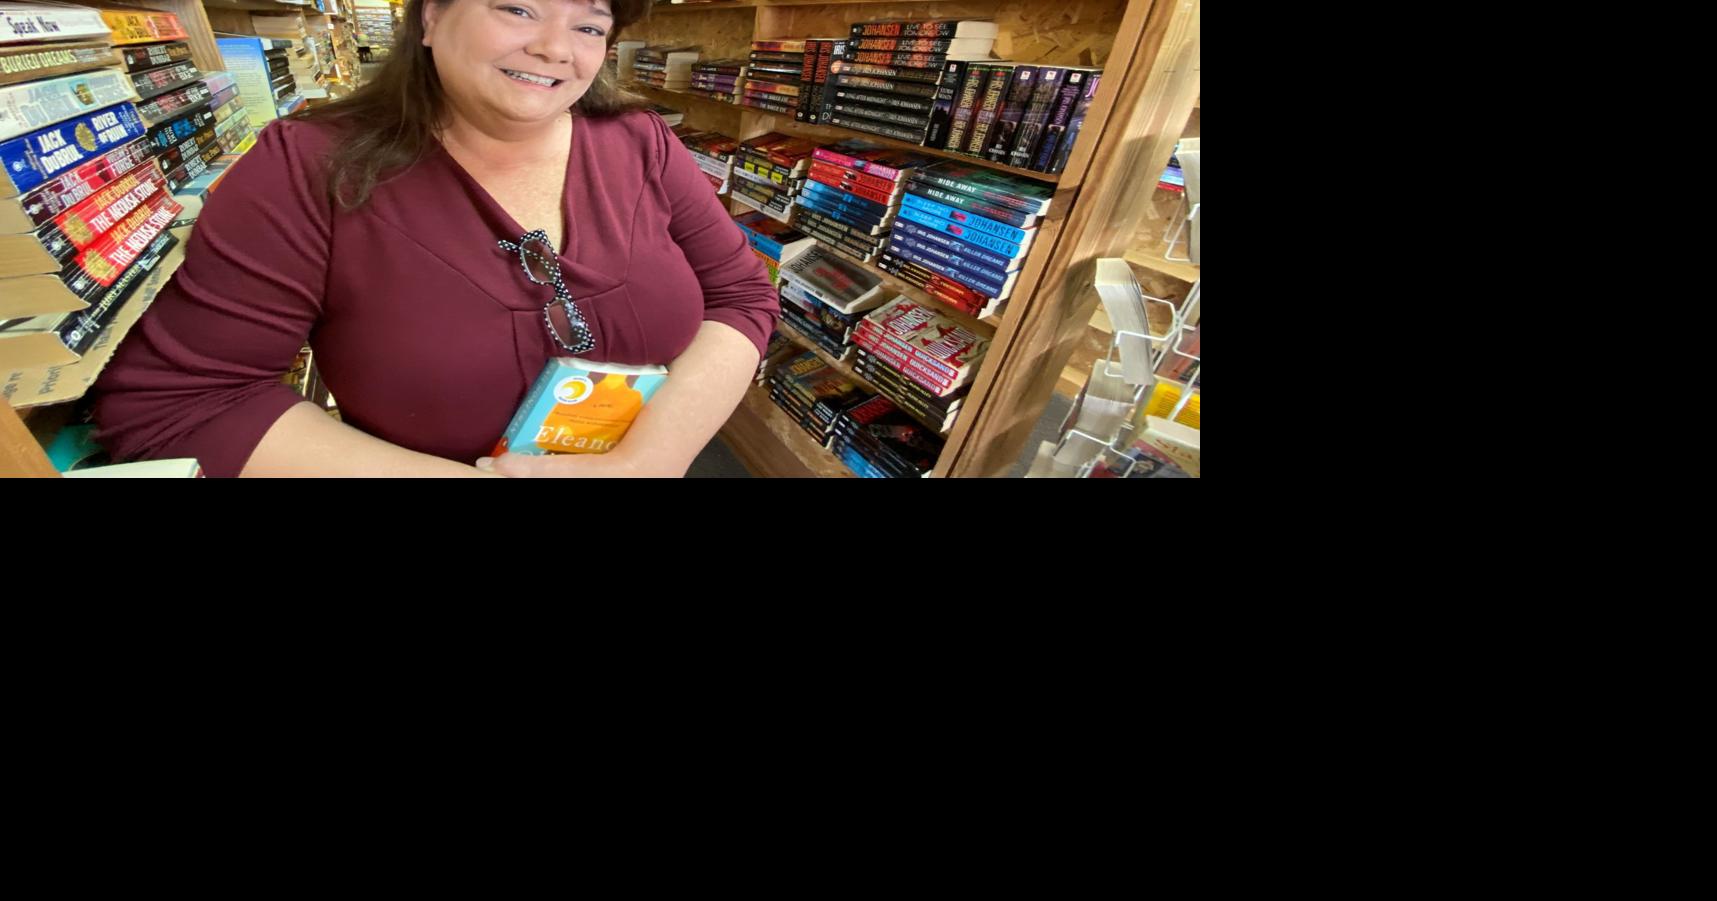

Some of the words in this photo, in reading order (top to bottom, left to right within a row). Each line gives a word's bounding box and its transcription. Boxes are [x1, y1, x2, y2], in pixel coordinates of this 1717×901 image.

[6, 17, 40, 37] Speak
[36, 16, 61, 33] Now
[862, 23, 900, 36] JOHANSEN
[858, 39, 897, 51] JOHANSEN
[0, 52, 40, 73] BURIED
[38, 49, 78, 67] DREAMS
[815, 55, 829, 83] JOHANSEN
[855, 53, 893, 65] JOHANSEN
[91, 112, 119, 132] RIVER
[107, 124, 129, 143] RUIN
[37, 129, 67, 154] JACK
[40, 144, 84, 174] DuBRUL
[110, 155, 136, 176] FORGE
[60, 171, 82, 191] JACK
[937, 178, 955, 188] HIDE
[956, 182, 977, 193] AWAY
[89, 211, 110, 233] THE
[108, 192, 137, 222] MEDUSA
[134, 179, 158, 202] STONE
[95, 189, 115, 210] JACK
[928, 188, 944, 199] HIDE
[944, 193, 964, 204] AWAY
[108, 245, 132, 266] THE
[124, 219, 156, 252] MEDUSA
[148, 206, 176, 232] STONE
[110, 223, 128, 245] JACK
[969, 216, 1019, 240] JOHANSEN
[926, 233, 950, 246] JOHANSEN
[963, 247, 981, 257] KILLER
[980, 253, 1004, 267] DREAMS
[965, 231, 1012, 255] JOHANSEN
[926, 246, 950, 259] JOHANSEN
[963, 261, 981, 272] KILLER
[980, 268, 1004, 281] DREAMS
[116, 264, 140, 289] MASTER
[921, 259, 945, 271] JOHANSEN
[958, 273, 975, 284] KILLER
[975, 280, 998, 293] DREAMS
[880, 341, 908, 361] JOHANSEN
[909, 359, 944, 384] QUICKSAND
[883, 332, 913, 352] JOHANSEN
[914, 350, 950, 374] QUICKSAND
[873, 349, 901, 369] JOHANSEN
[903, 366, 937, 391] QUICKSAND
[534, 425, 617, 450] Eleano
